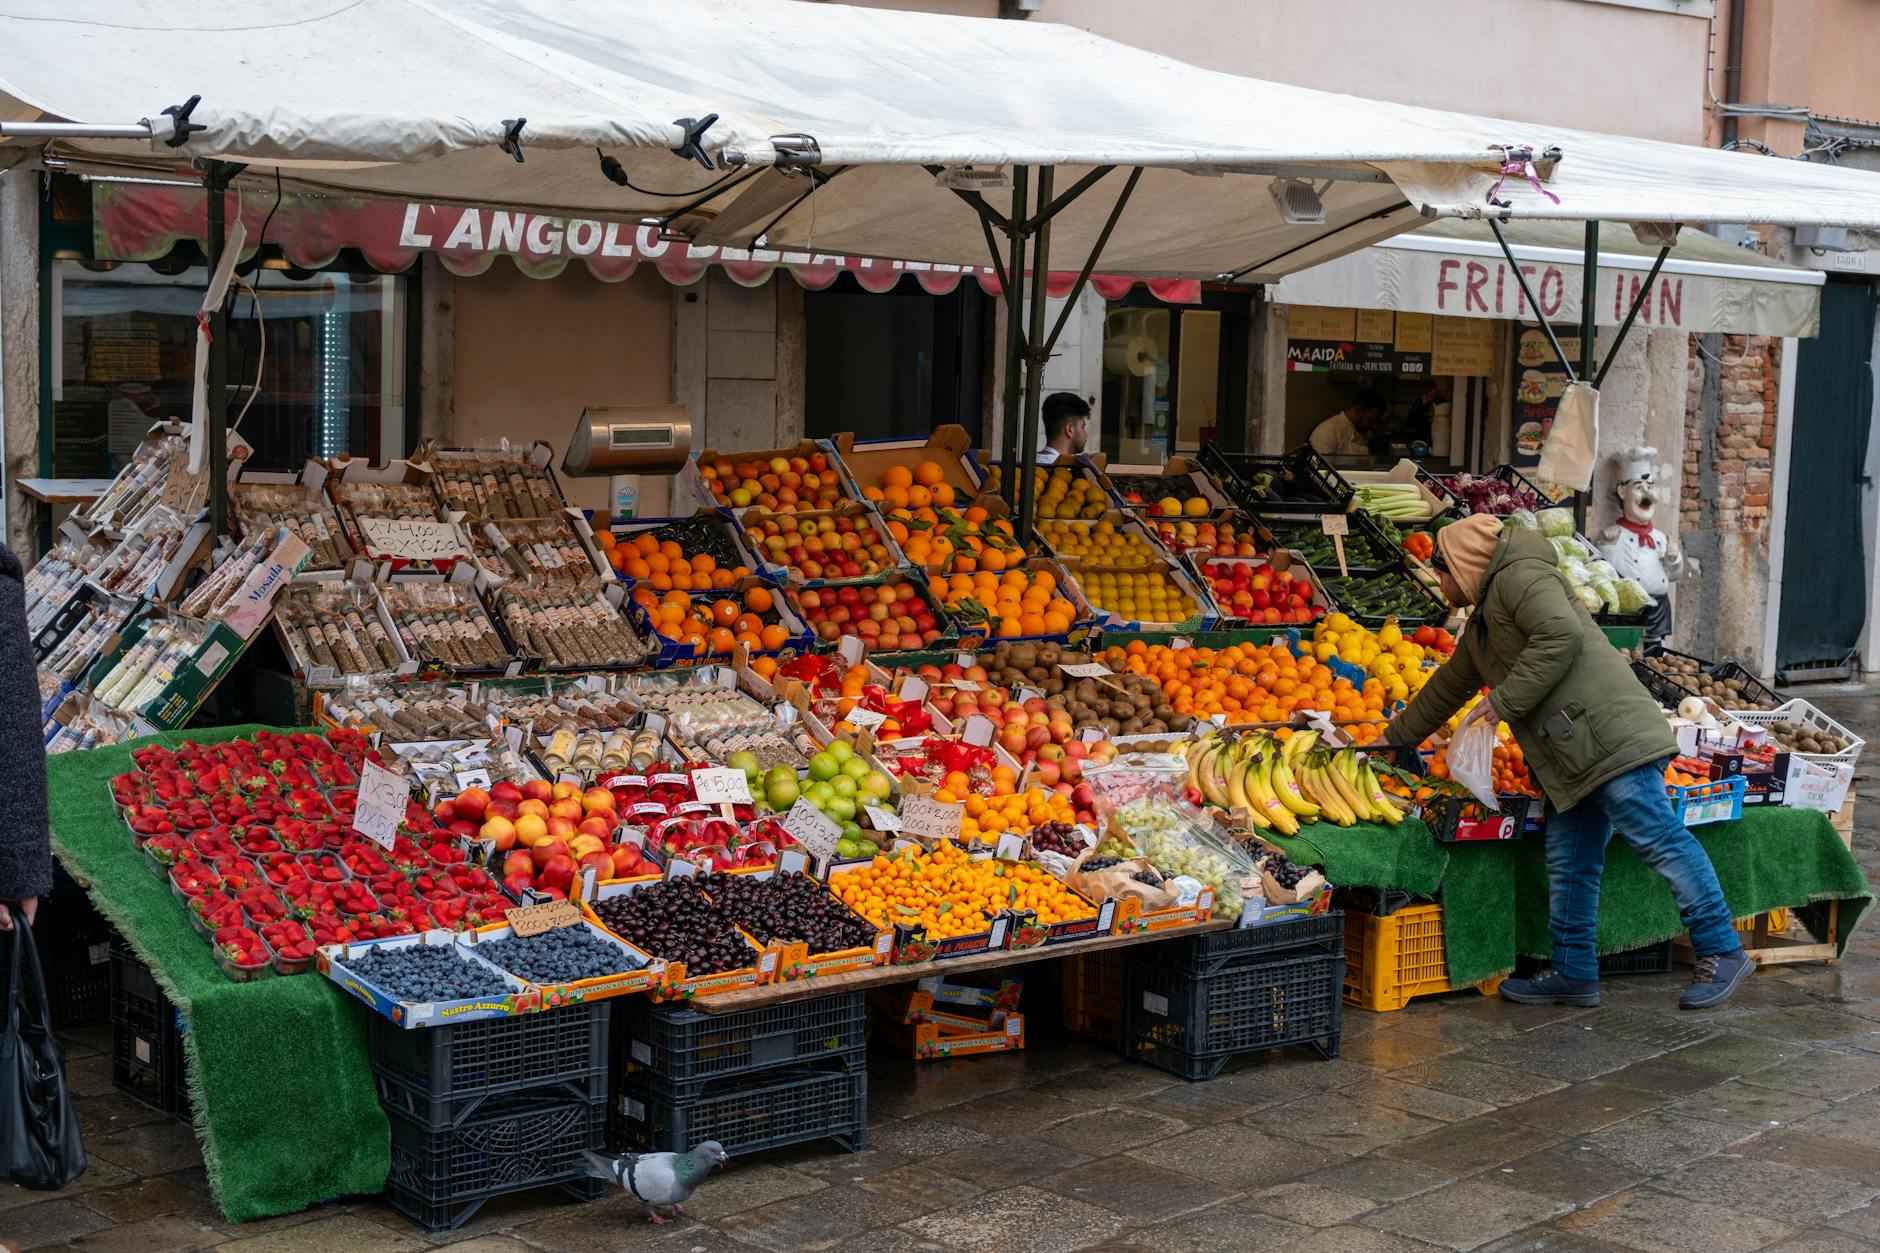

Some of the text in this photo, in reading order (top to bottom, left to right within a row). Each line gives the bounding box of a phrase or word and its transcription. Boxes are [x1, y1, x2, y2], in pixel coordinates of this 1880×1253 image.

[1437, 259, 1683, 327] FRITO INN
[475, 1000, 510, 1013] Azzurro
